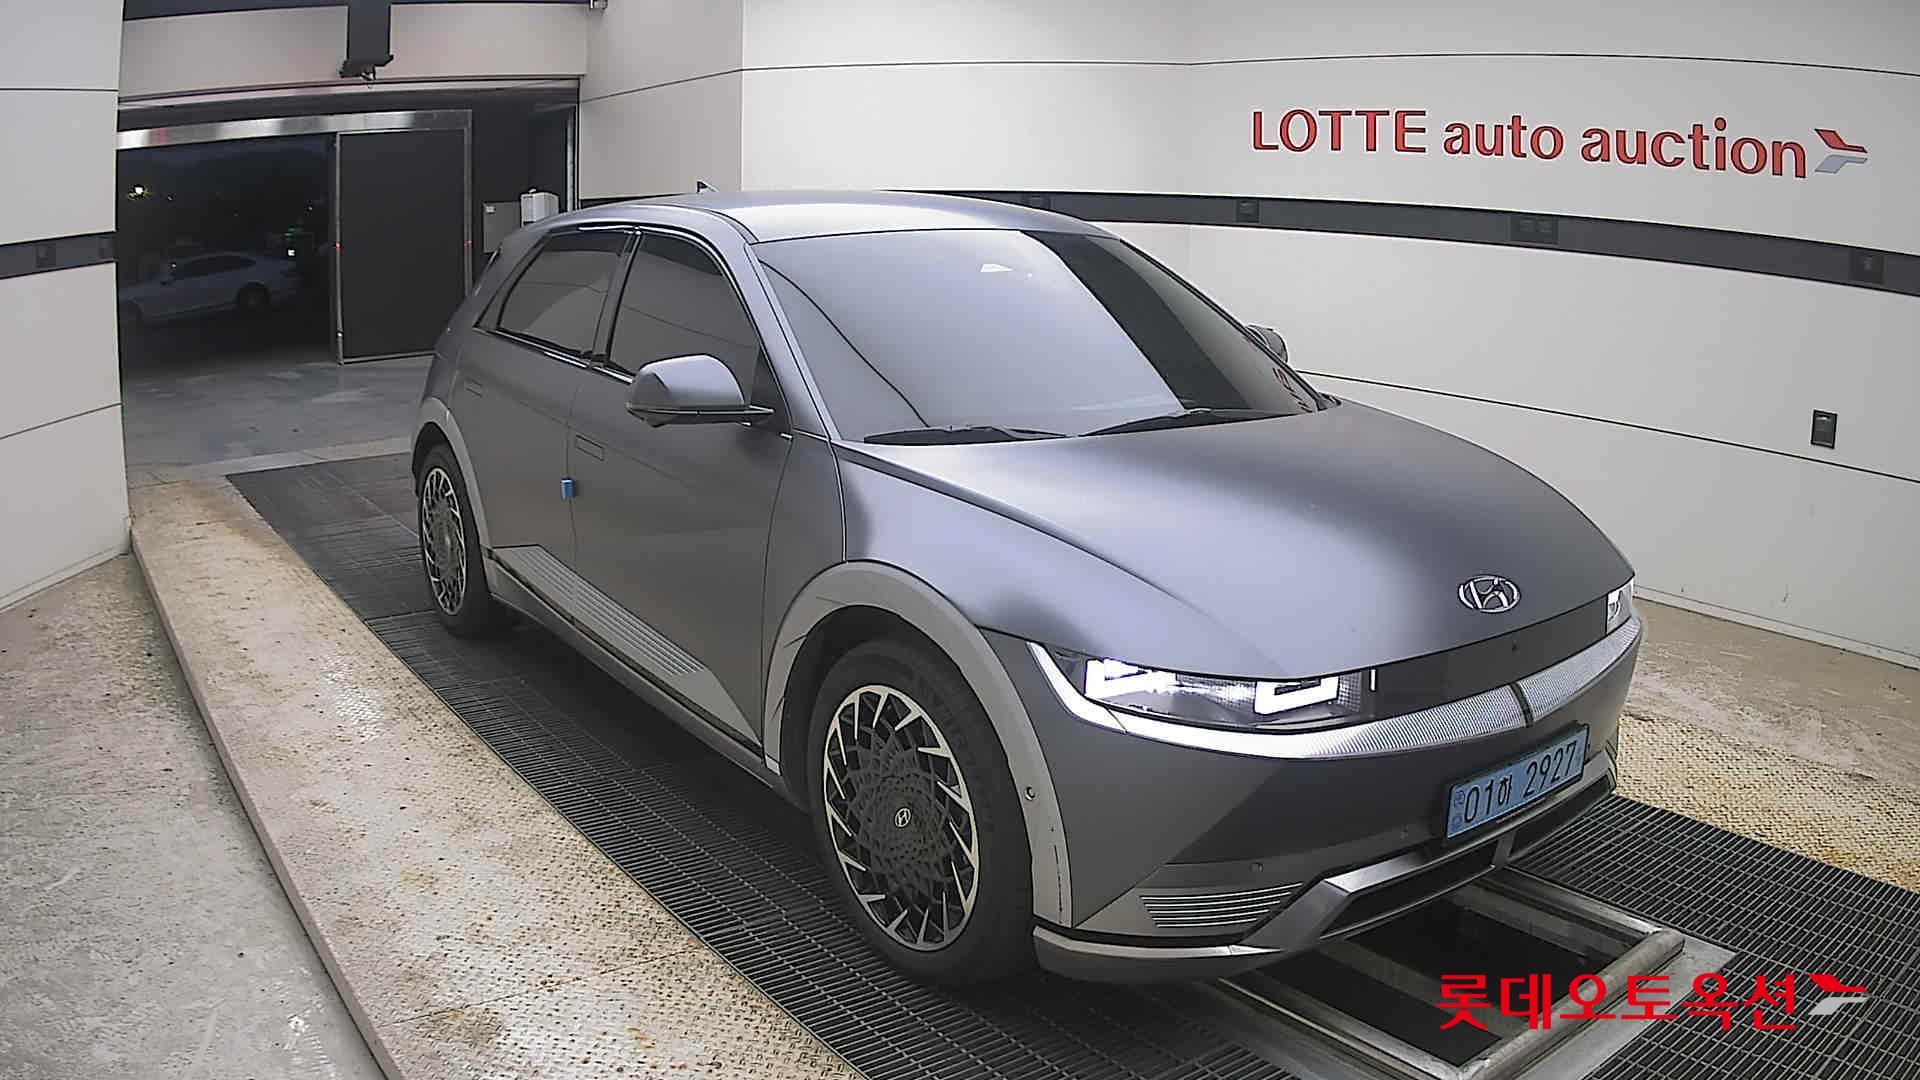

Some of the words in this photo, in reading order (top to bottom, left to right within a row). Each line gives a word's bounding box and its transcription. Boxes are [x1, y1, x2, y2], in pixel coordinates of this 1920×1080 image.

[1252, 110, 1427, 153] LOTTE
[1443, 115, 1565, 160] auto
[1581, 118, 1808, 178] auction
[1464, 774, 1513, 823] 01하
[1523, 740, 1577, 798] 2927
